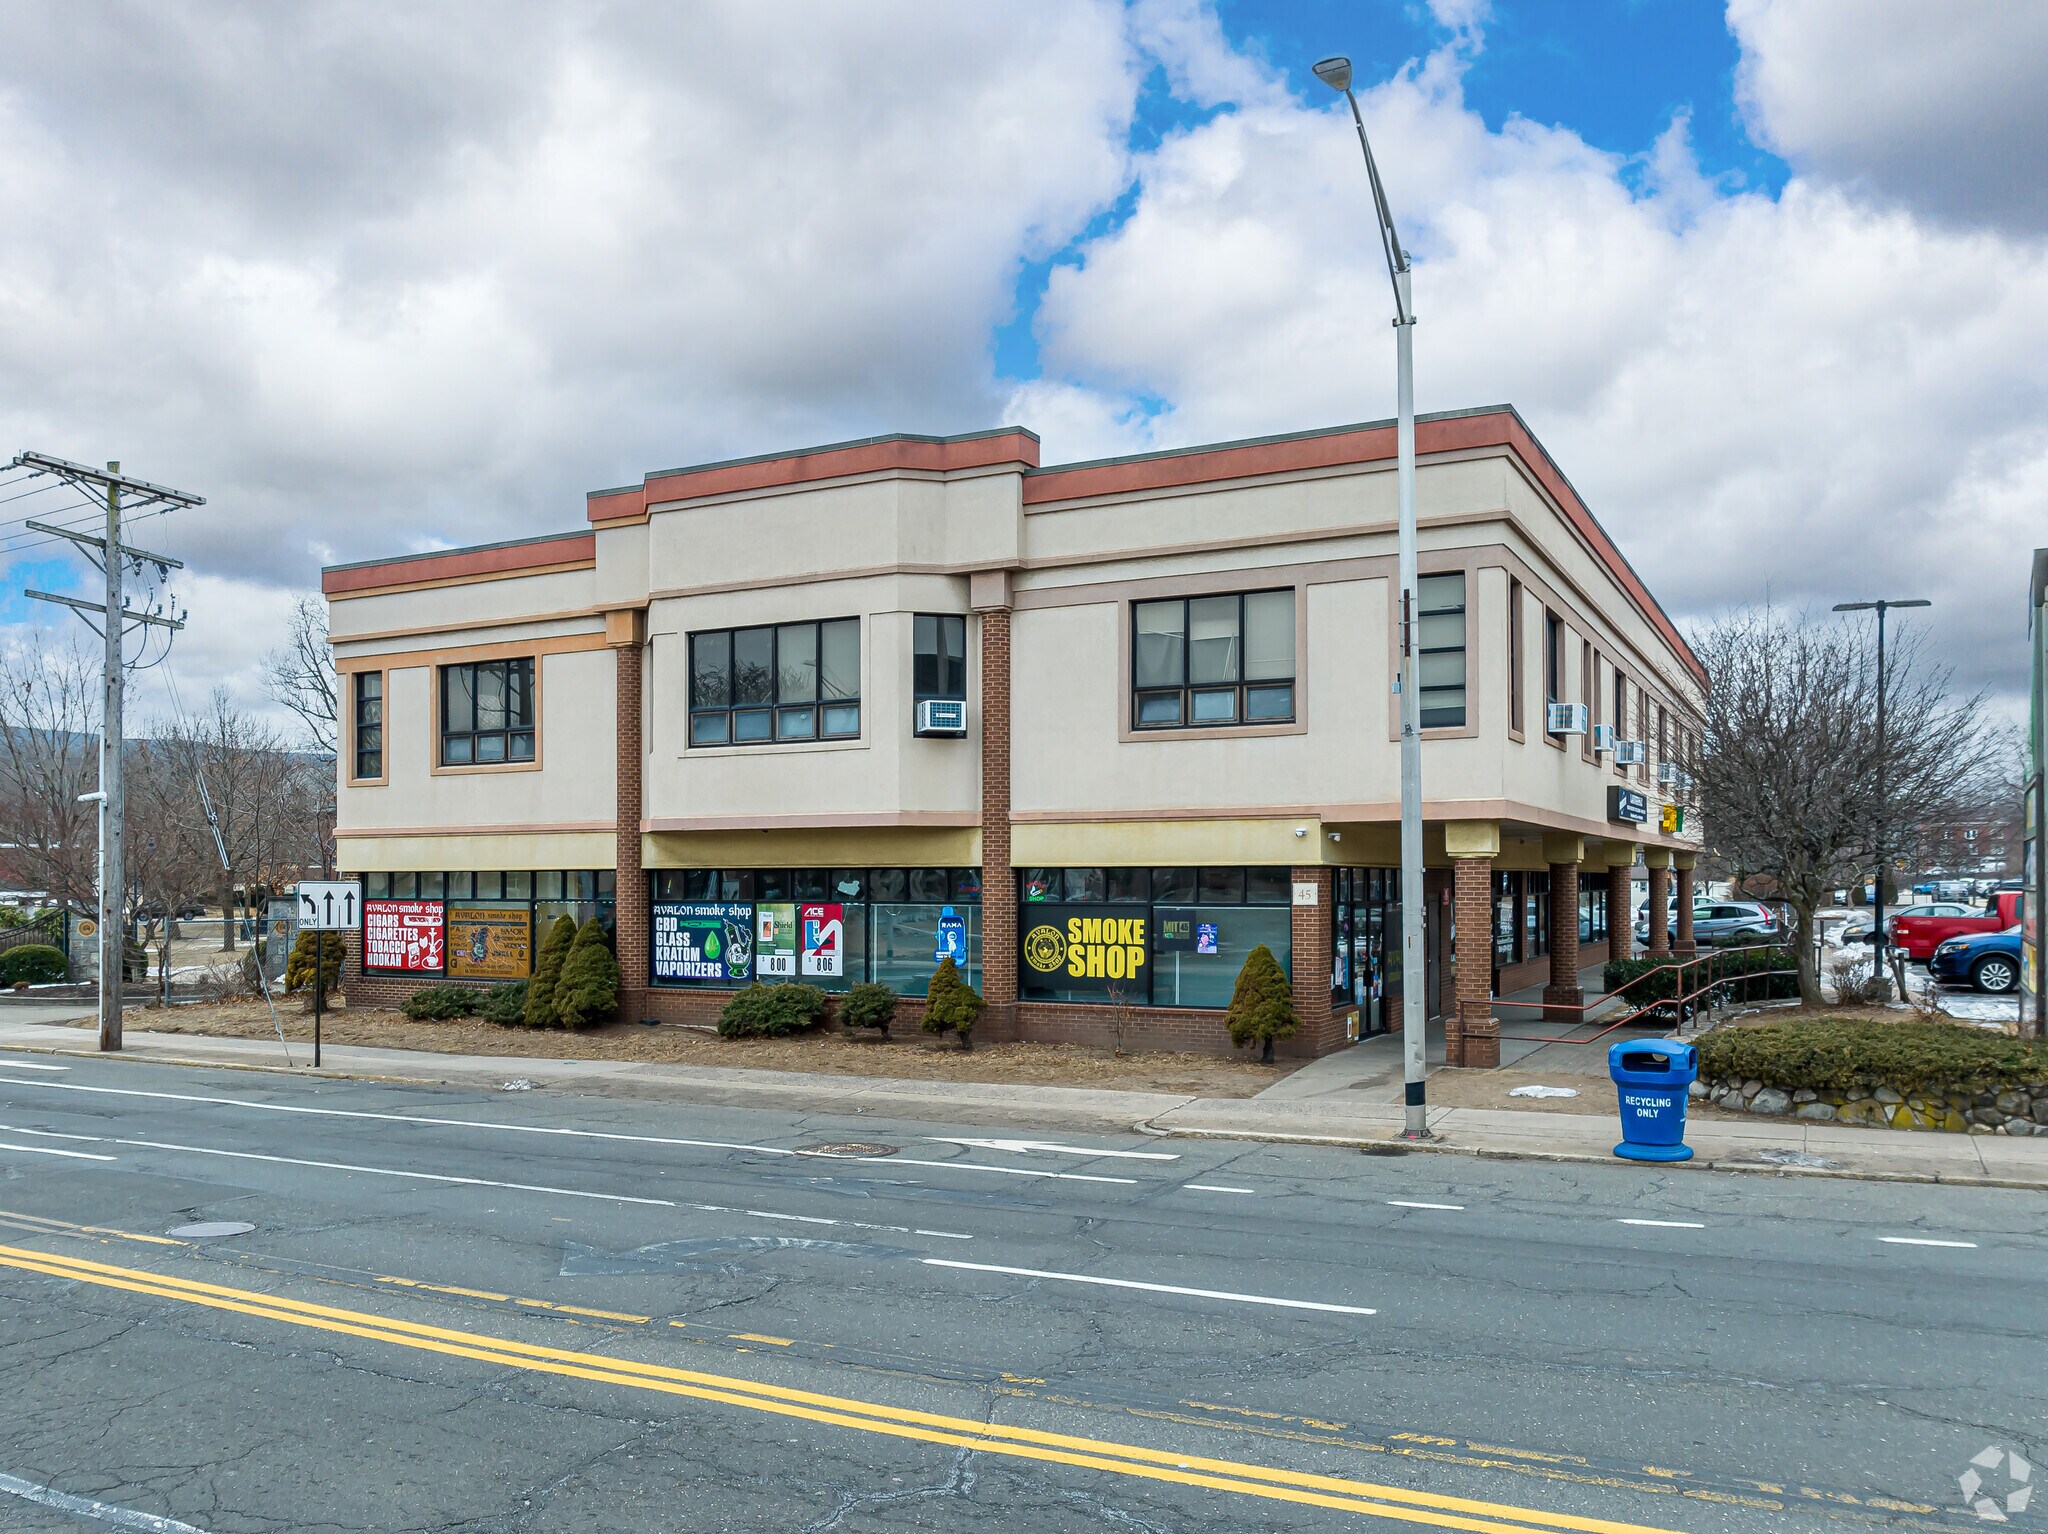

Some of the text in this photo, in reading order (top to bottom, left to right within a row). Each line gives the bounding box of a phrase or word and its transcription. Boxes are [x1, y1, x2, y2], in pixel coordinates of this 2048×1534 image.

[1298, 889, 1311, 900] 45
[366, 903, 443, 916] AVALON smoke shop
[653, 905, 693, 915] AVALON
[695, 904, 726, 916] smoke
[728, 904, 752, 919] shop
[804, 907, 824, 916] ACE
[299, 918, 317, 926] ONLY
[367, 914, 399, 927] CIGARS
[655, 917, 678, 932] CBD
[774, 921, 793, 929] Shield
[367, 927, 418, 941] CIGARETTES
[1031, 928, 1060, 940] AVALON
[1067, 917, 1145, 945] SMOKE
[655, 932, 691, 947] GLASS
[367, 940, 406, 954] TOBACCO
[655, 946, 700, 962] KRATOM
[367, 953, 402, 967] HOOKAH
[1067, 944, 1145, 979] SHOP
[655, 961, 722, 978] VAPORIZERS
[1625, 1095, 1671, 1107] RECYCLING
[1636, 1108, 1659, 1118] ONLY
